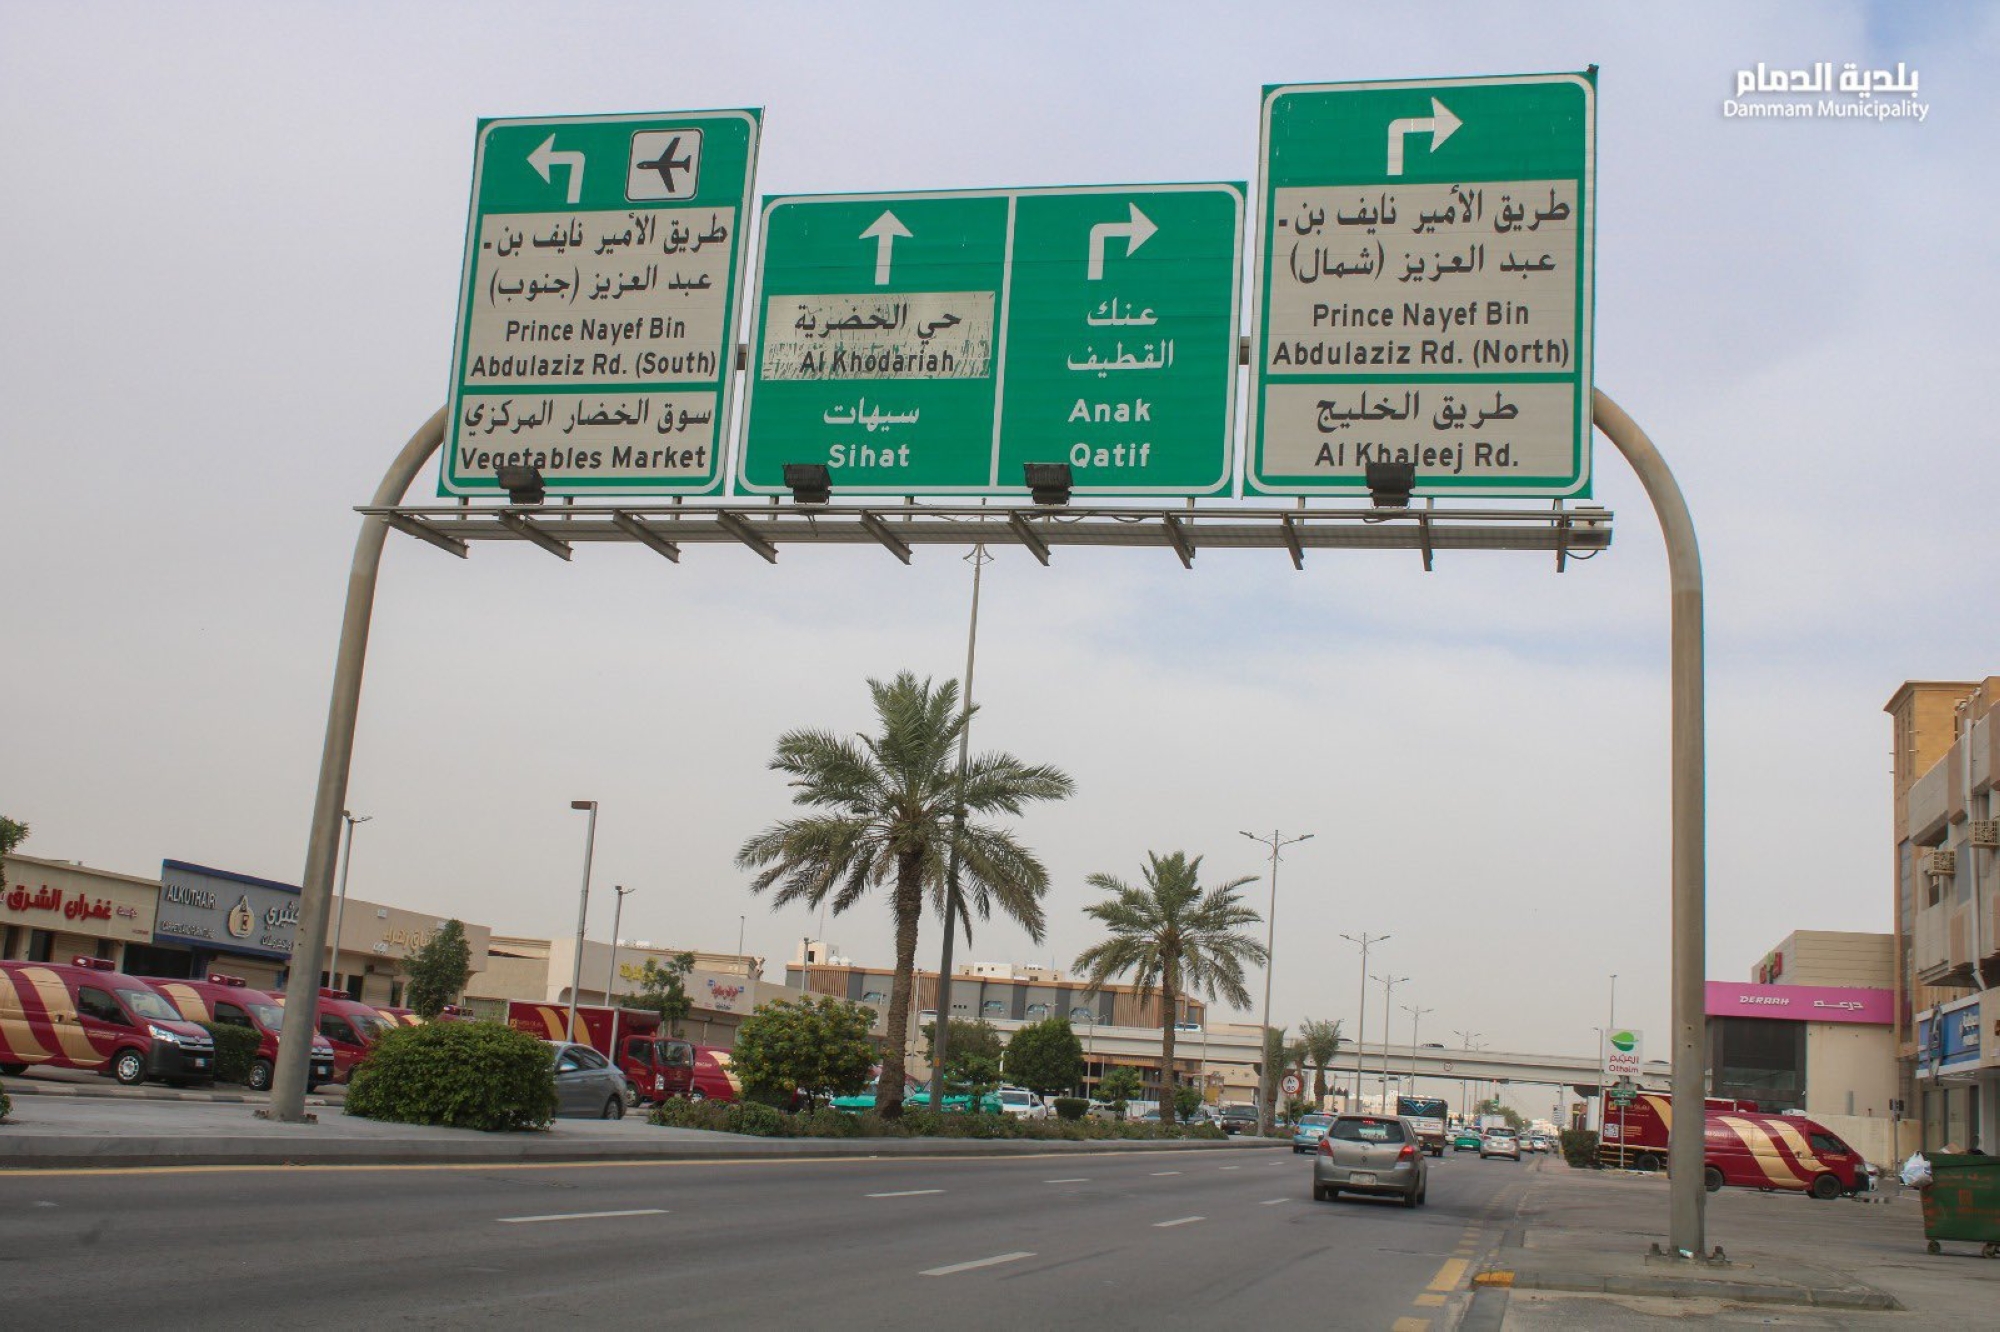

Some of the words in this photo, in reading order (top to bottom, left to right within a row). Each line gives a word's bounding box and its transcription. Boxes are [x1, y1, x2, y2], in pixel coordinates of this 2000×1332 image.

[1337, 192, 1397, 235] نايف
[1411, 183, 1483, 234] الأمير
[1494, 188, 1571, 233] طريق
[532, 216, 584, 254] نايف
[594, 212, 657, 256] الأمير
[663, 213, 728, 254] طريق
[1290, 239, 1385, 284] (شمال)
[1397, 243, 1484, 282] العزيز
[1499, 253, 1557, 281] عبد
[489, 266, 580, 308] (جنوب)
[589, 265, 658, 300] العزيز
[668, 270, 712, 297] عبد
[795, 303, 907, 339] الخضرية
[1087, 297, 1159, 327] عنك
[1312, 303, 1394, 327] Prince
[1402, 302, 1477, 333] Nayef
[1486, 301, 1529, 325] Bin
[506, 319, 574, 342] Prince
[580, 318, 644, 345] Nayef
[649, 317, 686, 339] Bin
[917, 313, 962, 345] حي
[470, 354, 585, 377] Abdulaziz
[592, 353, 628, 375] Rd.
[635, 351, 717, 380] (South)
[800, 350, 824, 373] Al
[832, 349, 954, 373] Khodariah
[1067, 339, 1175, 379] القطيف
[1272, 341, 1411, 365] Abdulaziz
[1420, 340, 1463, 365] Rd.
[1473, 339, 1570, 368] (North)
[464, 399, 554, 437] المركزي
[563, 398, 649, 435] الخضار
[657, 406, 712, 435] سوق
[823, 396, 920, 432] سيهات
[1067, 398, 1152, 423] Anak
[1316, 390, 1420, 432] الخليج
[1432, 391, 1519, 430] طريق
[461, 446, 603, 470] Vegetables
[611, 445, 707, 469] Market
[827, 443, 910, 468] Sihat
[1069, 442, 1151, 468] Qatif
[1314, 442, 1344, 466] Al
[1355, 442, 1464, 474] Khaleej
[1474, 442, 1519, 467] Rd.
[6, 884, 62, 911] الشرق
[64, 893, 111, 921] غفران
[1608, 1064, 1639, 1074] Othaim
